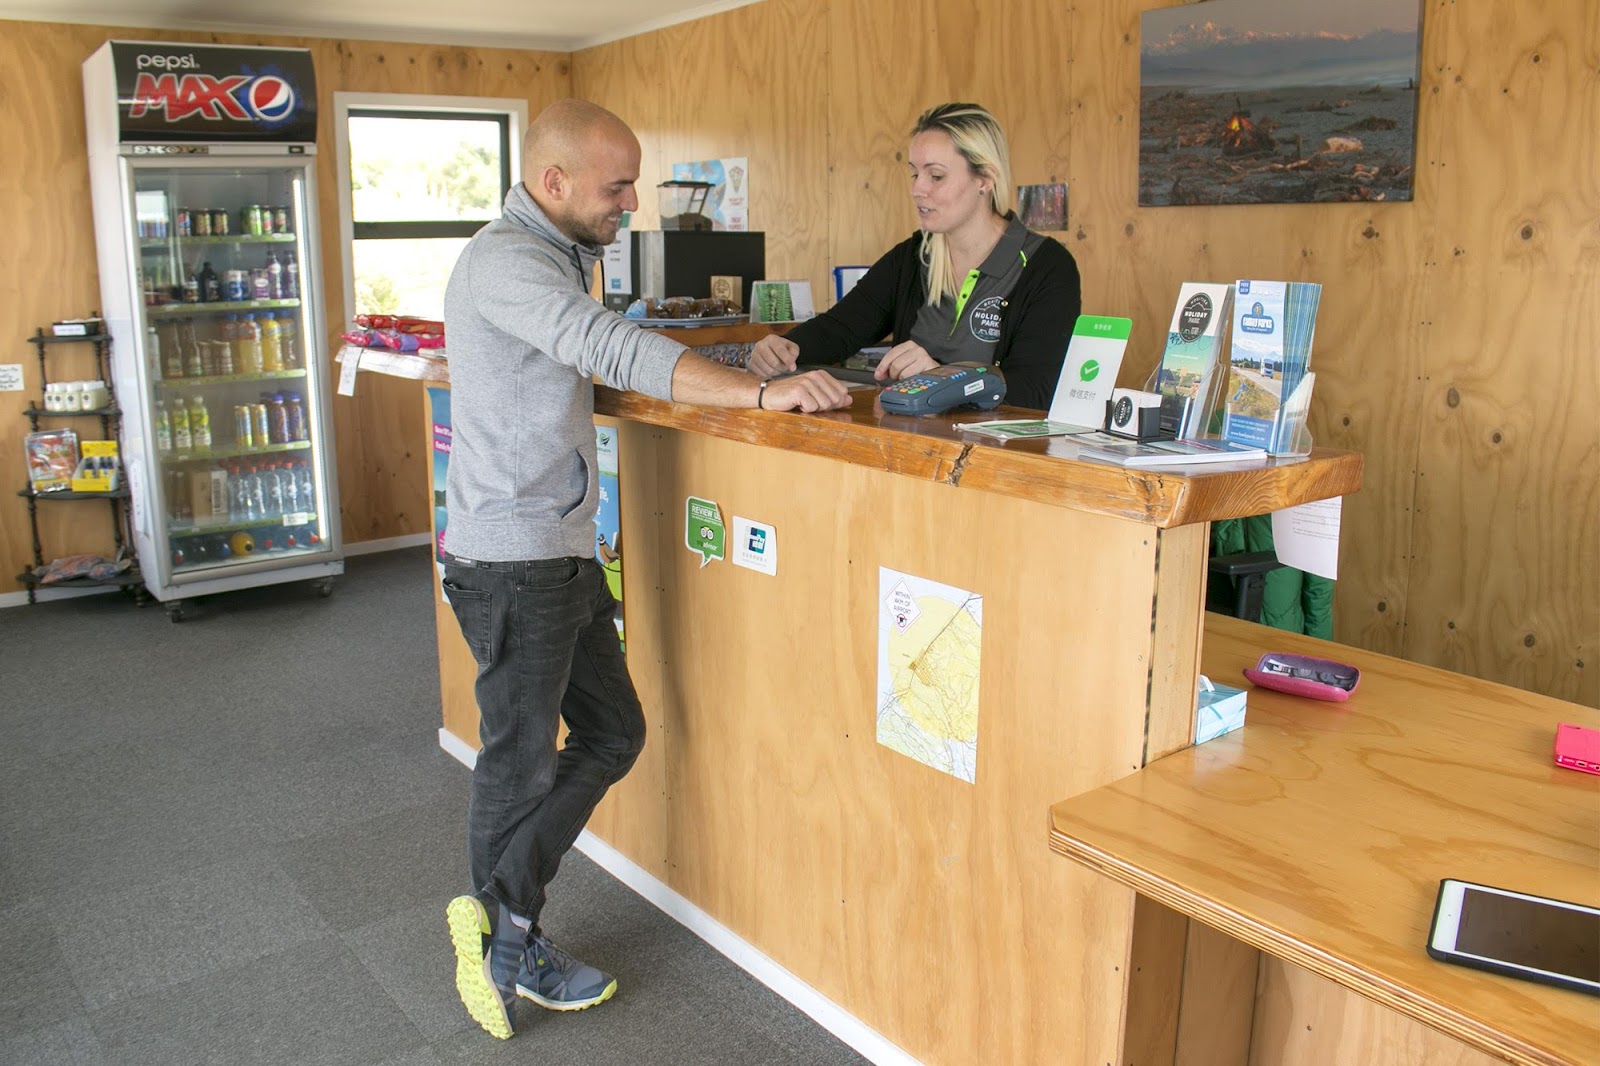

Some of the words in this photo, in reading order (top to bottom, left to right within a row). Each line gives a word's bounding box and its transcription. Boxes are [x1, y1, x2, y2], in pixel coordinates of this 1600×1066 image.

[136, 54, 195, 71] pepsi
[128, 73, 254, 122] MAX
[975, 311, 1002, 322] HOLID
[981, 319, 1000, 328] PARK
[691, 505, 713, 518] REVIEW
